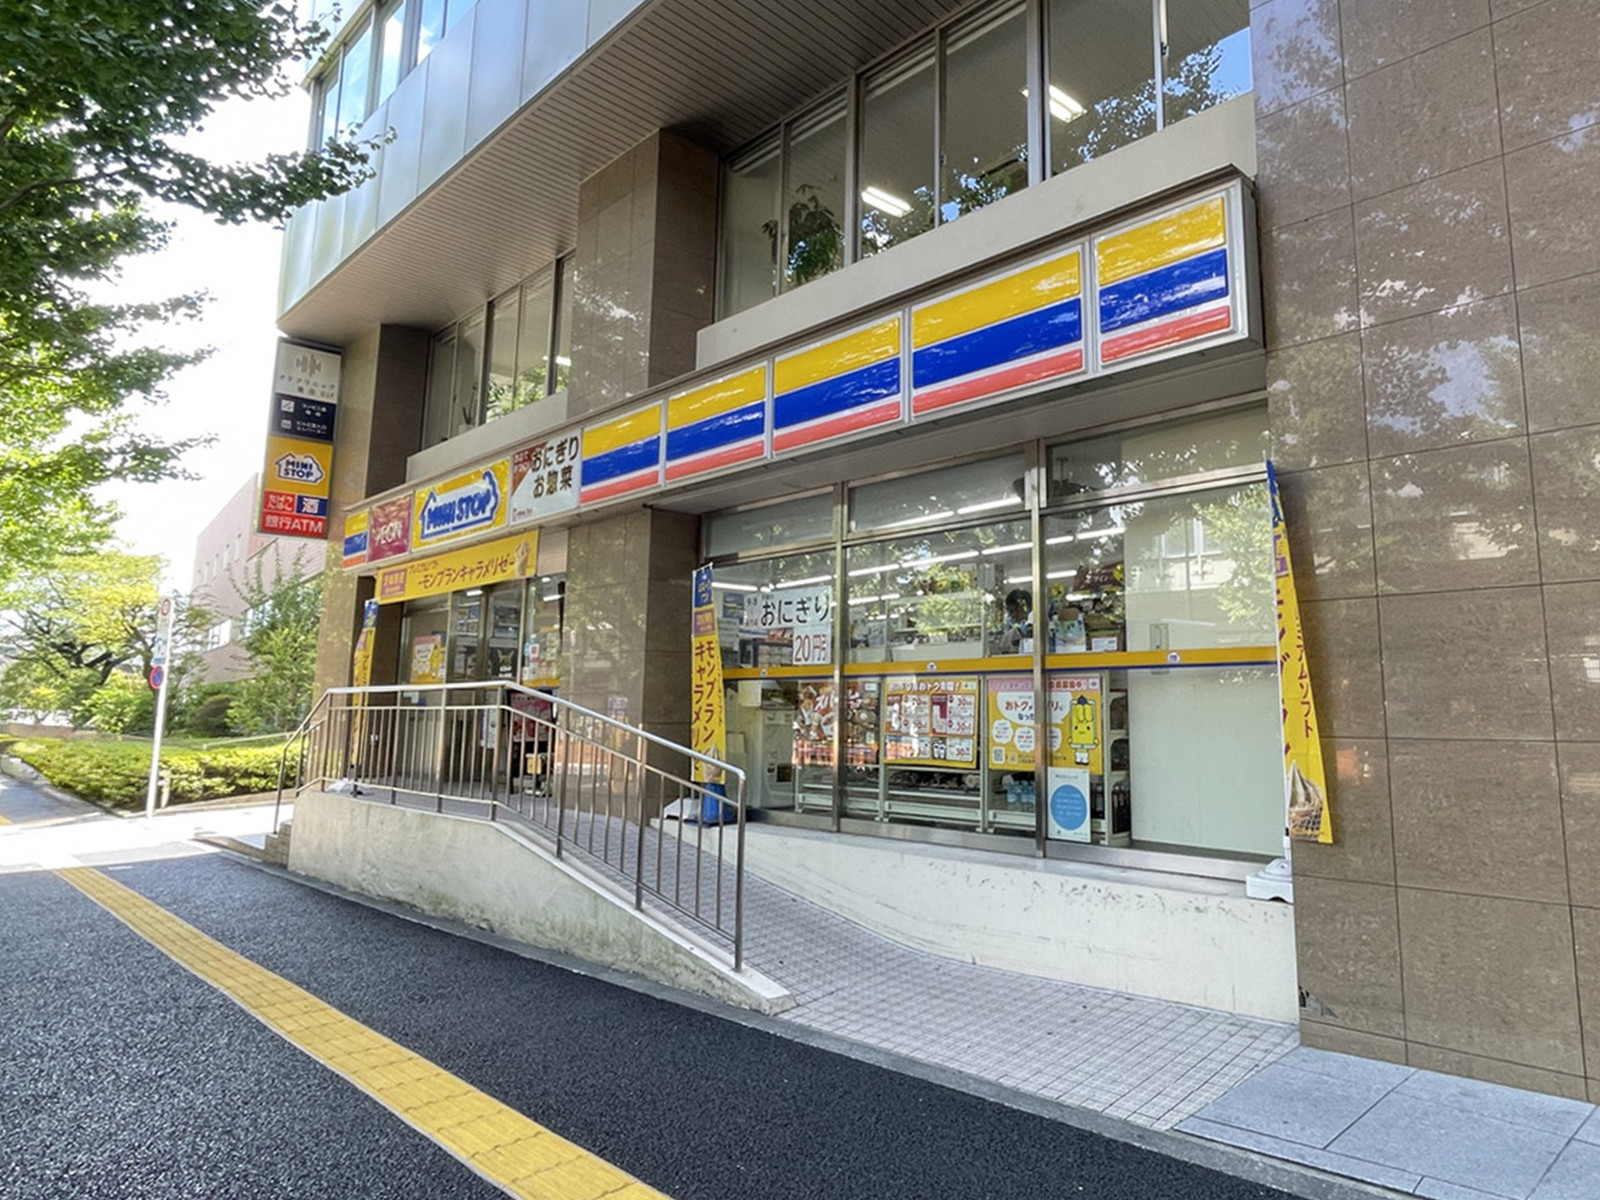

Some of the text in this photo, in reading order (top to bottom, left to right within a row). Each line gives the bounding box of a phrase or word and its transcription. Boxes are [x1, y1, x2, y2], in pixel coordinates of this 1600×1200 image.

[531, 436, 579, 473] おにぎり
[283, 468, 314, 478] STOP
[285, 460, 313, 470] MINI
[267, 494, 294, 511] たばこ
[302, 497, 320, 514] 酒
[427, 500, 456, 530] MINI
[456, 488, 491, 522] STOP
[265, 514, 323, 533] 銀行ATM
[761, 594, 830, 626] おにぎり
[704, 641, 716, 744] モンブラン
